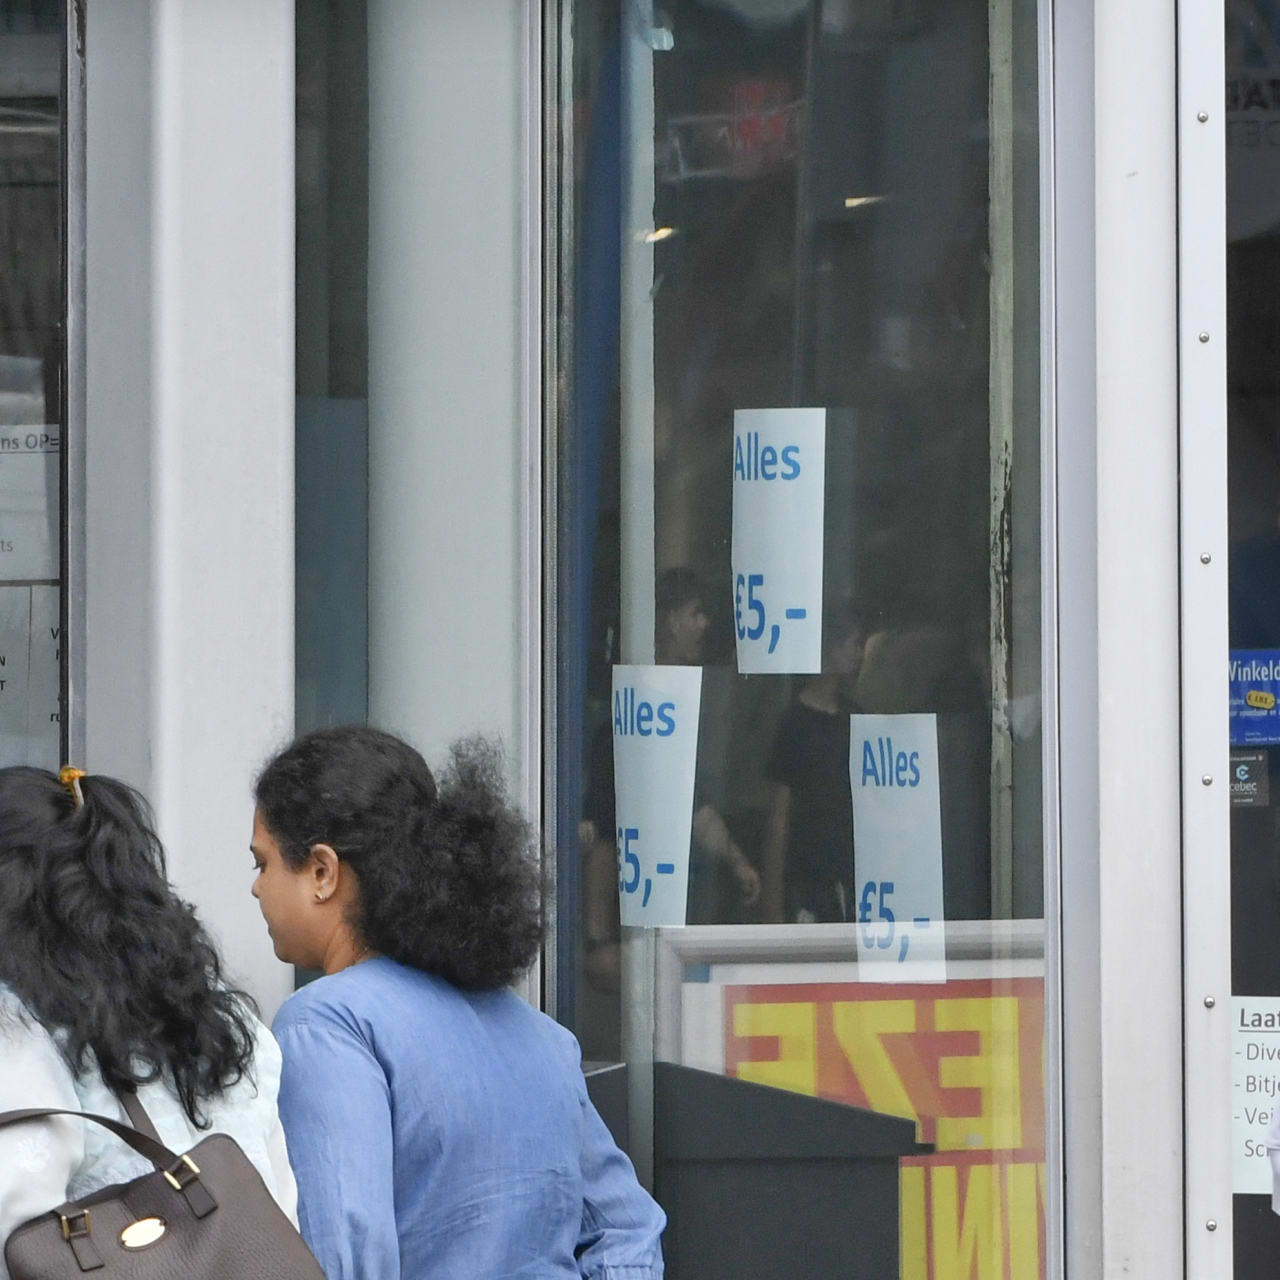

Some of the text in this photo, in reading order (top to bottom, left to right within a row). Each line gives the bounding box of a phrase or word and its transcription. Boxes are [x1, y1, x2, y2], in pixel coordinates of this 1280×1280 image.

[735, 432, 801, 481] Alles
[862, 737, 921, 788] Alles
[859, 881, 931, 964] €5,-
